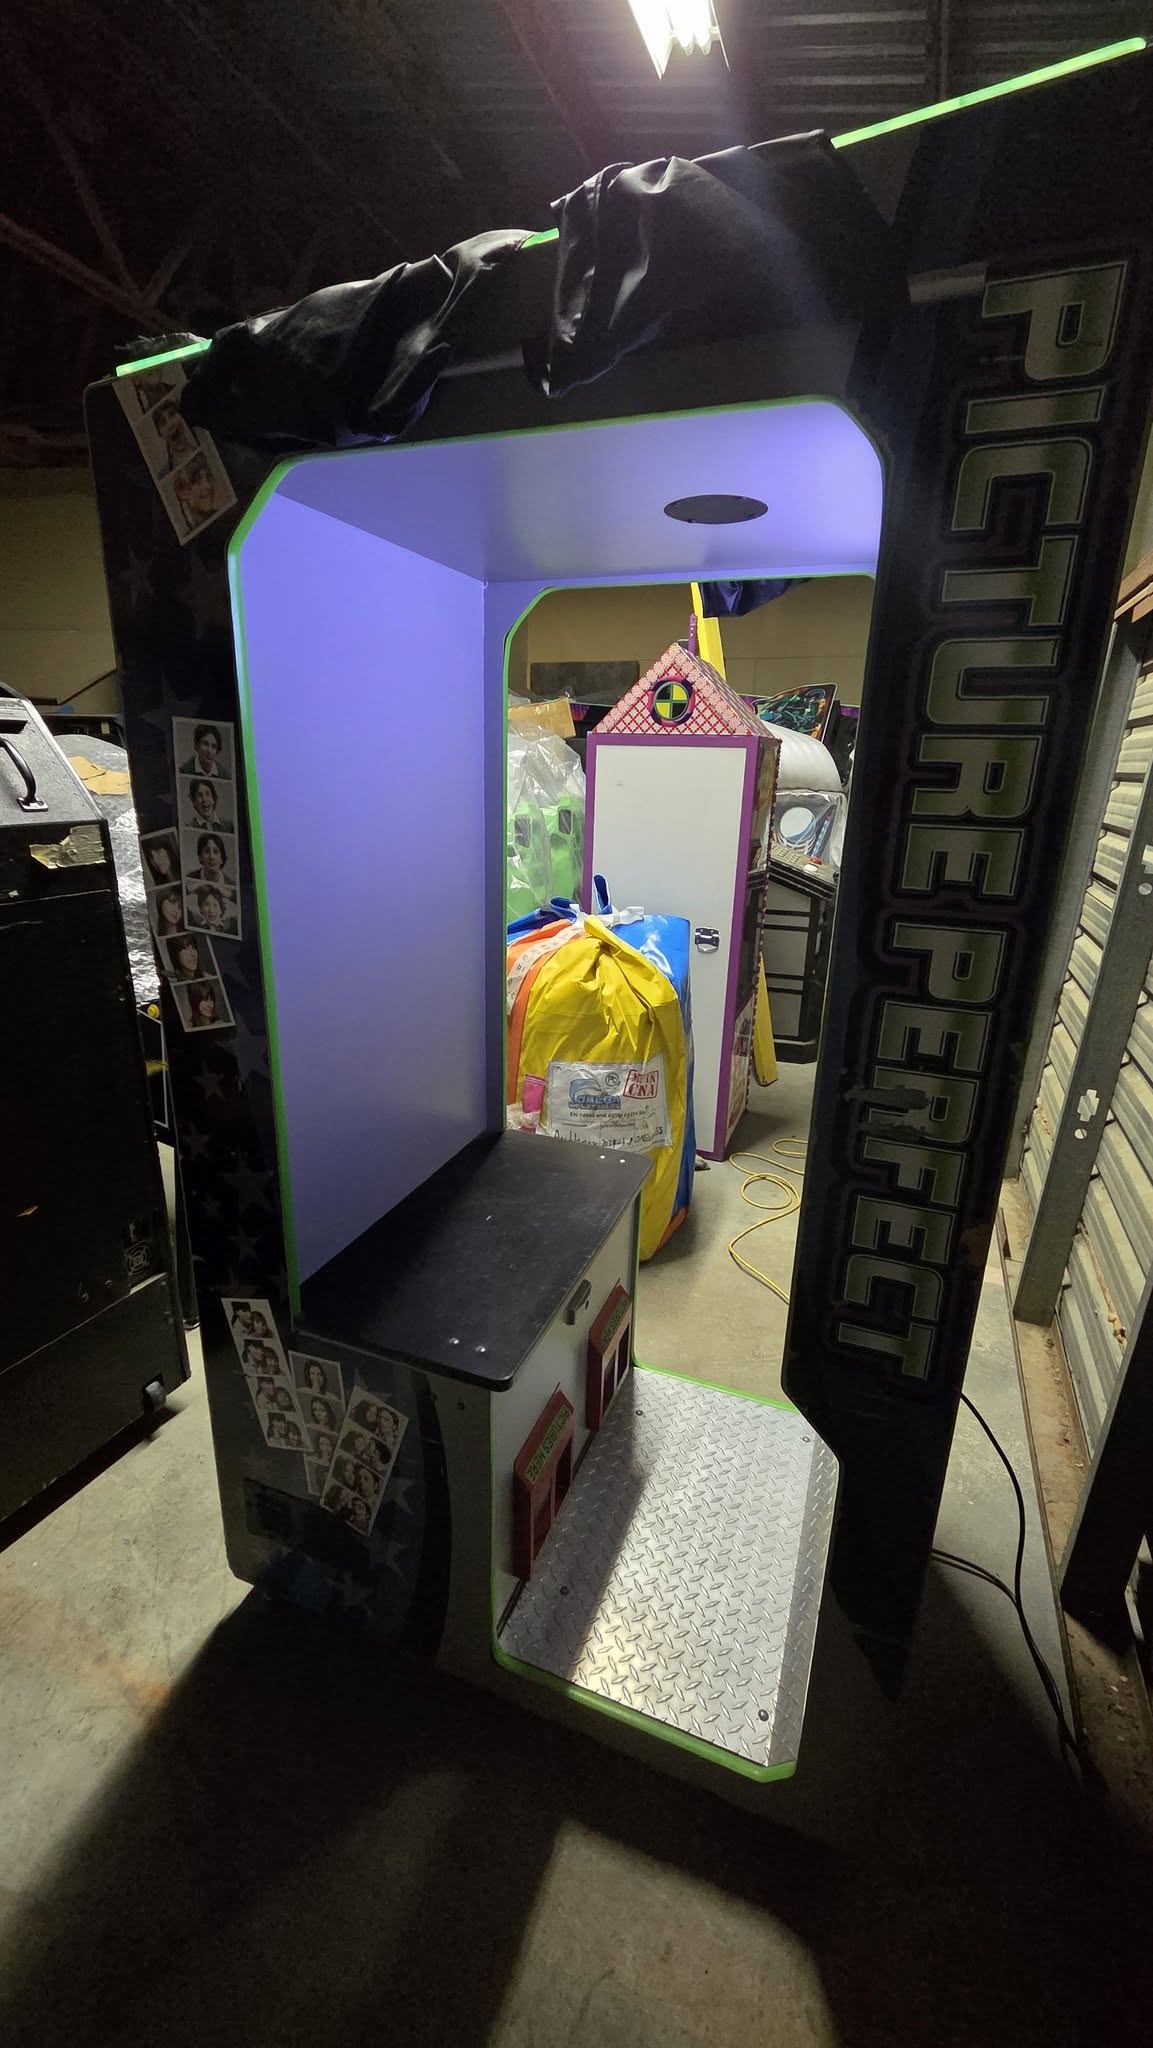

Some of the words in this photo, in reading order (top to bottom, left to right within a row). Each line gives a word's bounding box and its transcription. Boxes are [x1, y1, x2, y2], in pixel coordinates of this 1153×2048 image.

[899, 257, 1130, 902] PICTURE
[575, 1095, 621, 1104] OMEGA
[834, 919, 1010, 1383] PERFECT
[527, 1446, 547, 1483] HERE
